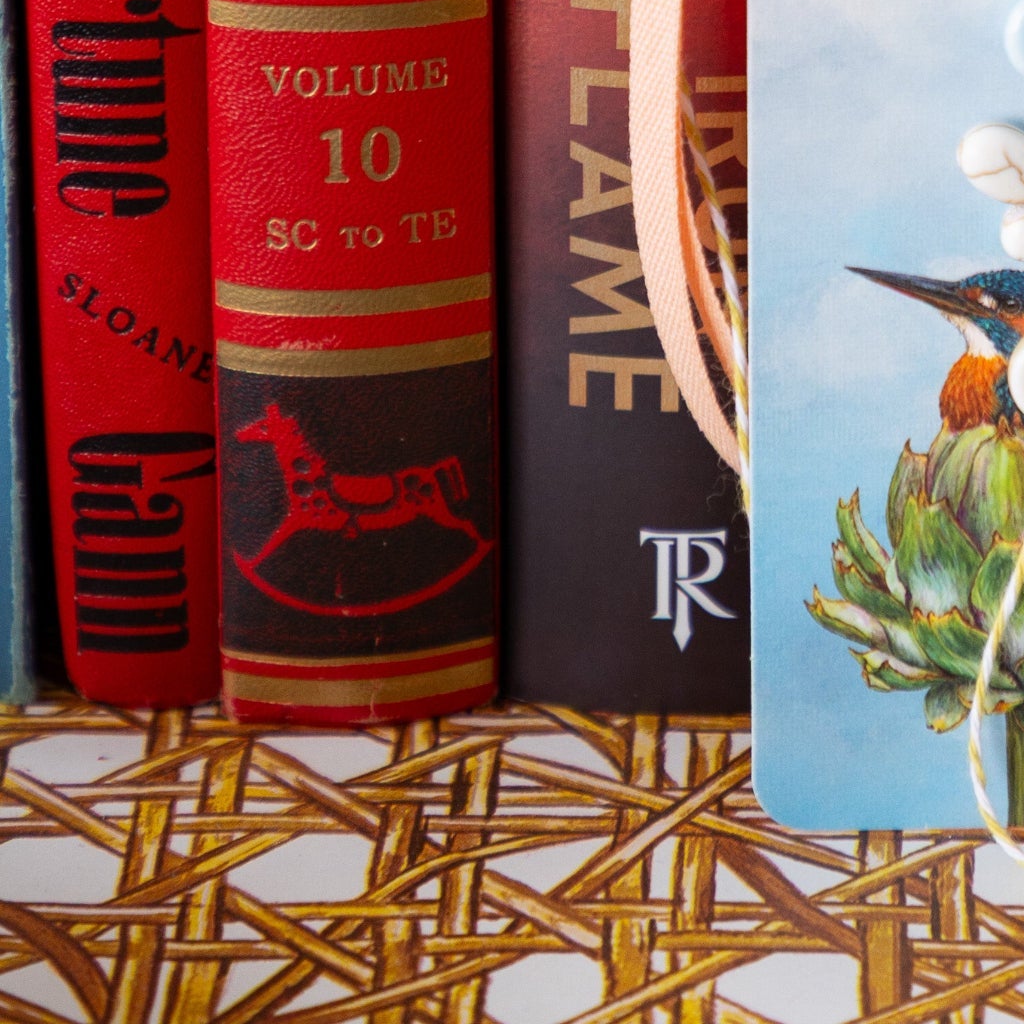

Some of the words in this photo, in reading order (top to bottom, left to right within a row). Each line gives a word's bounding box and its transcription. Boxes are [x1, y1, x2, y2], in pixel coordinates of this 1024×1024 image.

[260, 57, 449, 98] VOLUME
[319, 126, 403, 184] 10
[265, 217, 319, 251] SC
[338, 225, 385, 249] TO
[399, 207, 458, 244] TE
[57, 272, 213, 384] SLOANE
[67, 431, 216, 655] Gann
